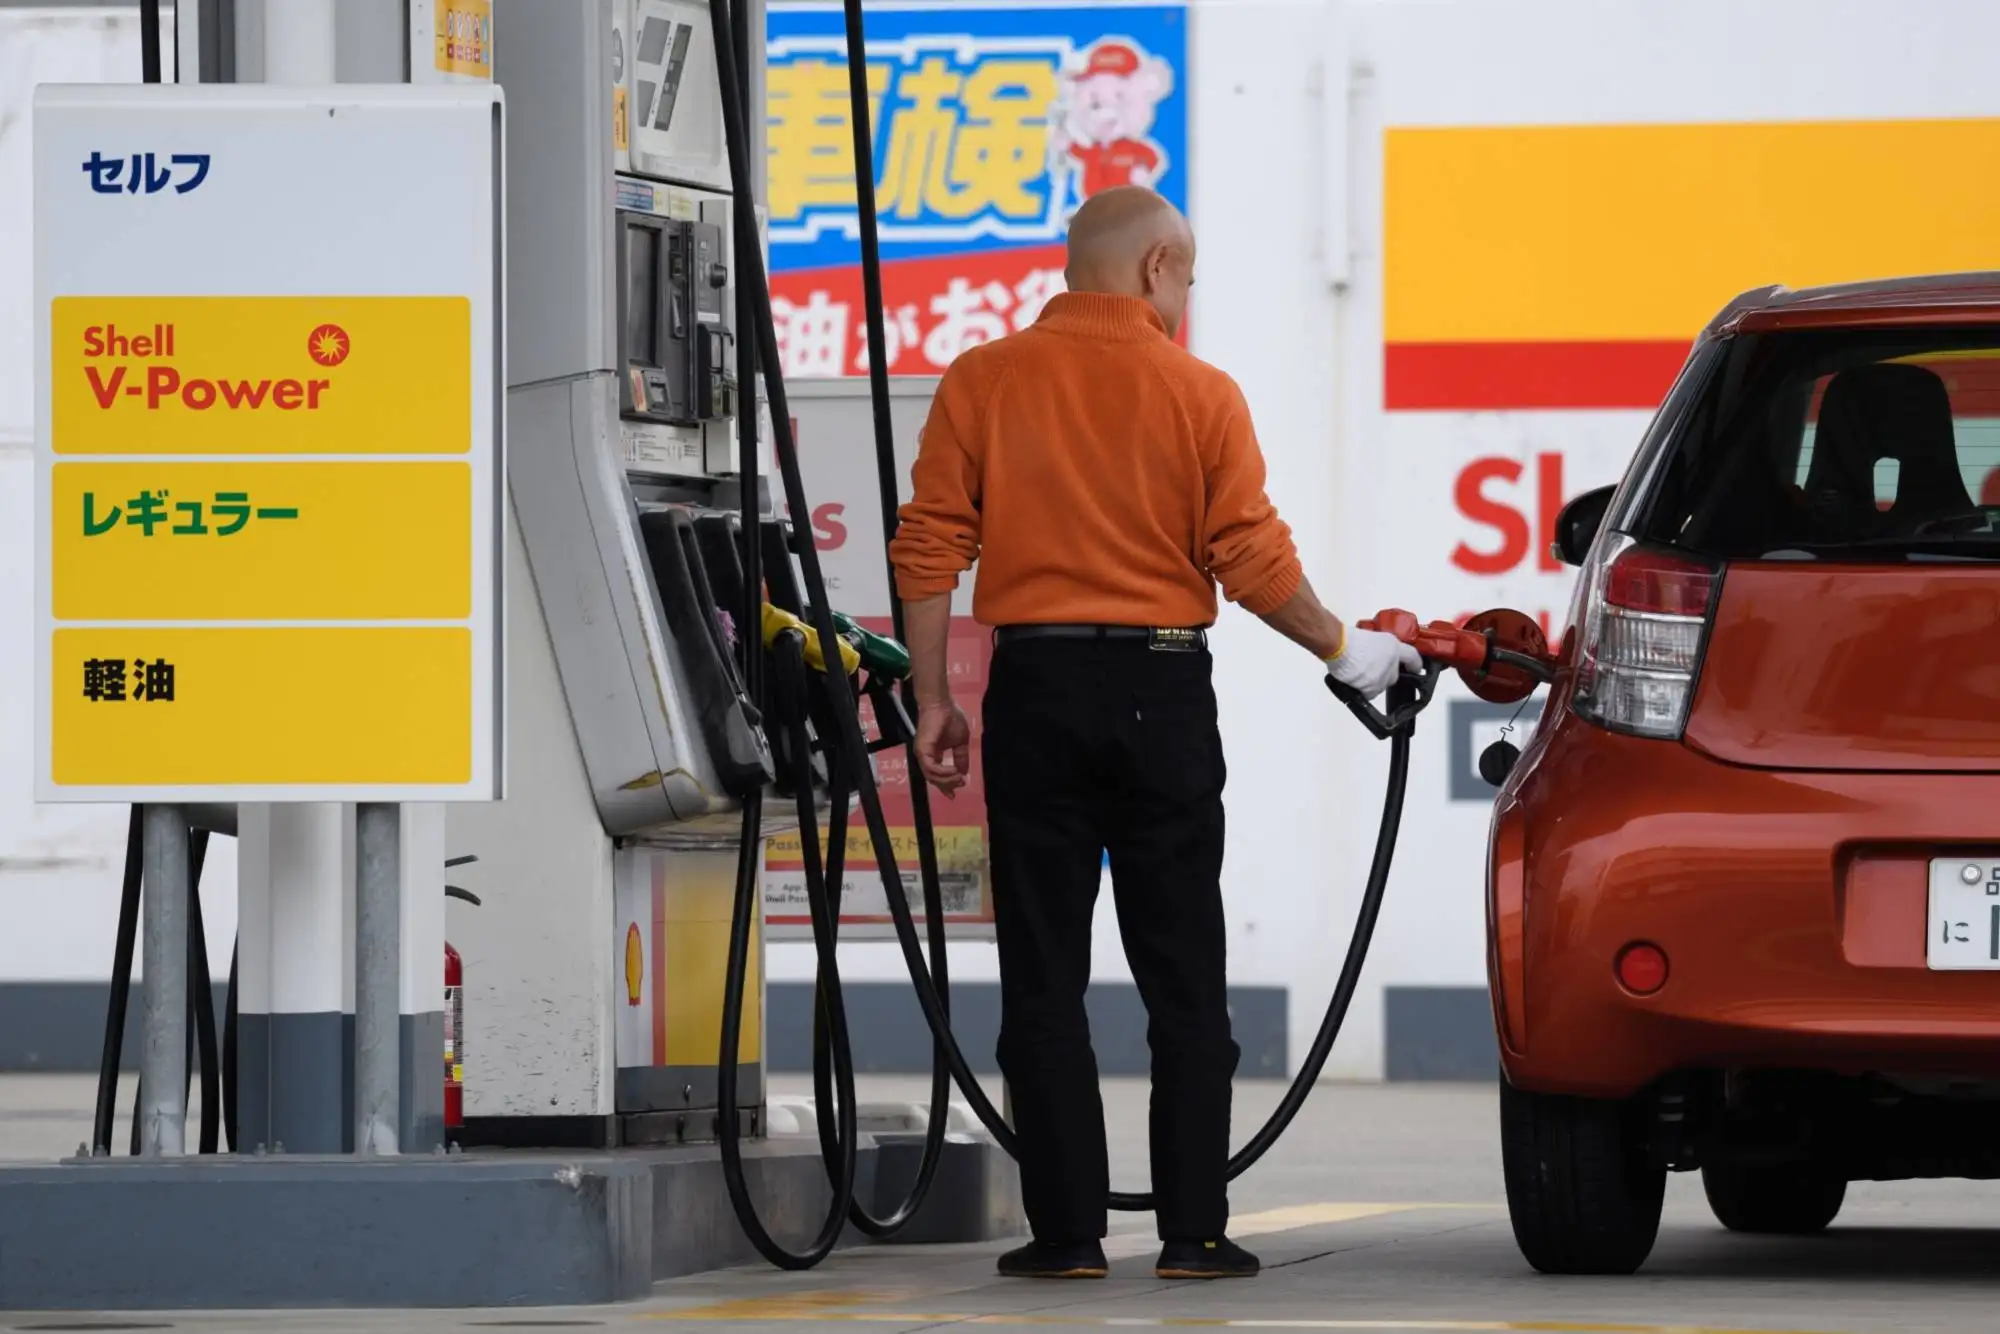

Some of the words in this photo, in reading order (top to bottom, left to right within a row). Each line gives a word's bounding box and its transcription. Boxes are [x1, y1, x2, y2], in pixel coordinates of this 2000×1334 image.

[82, 151, 211, 195] セルフ
[84, 324, 174, 357] Shell
[84, 367, 330, 410] V-Power
[83, 489, 299, 537] レギュラー
[83, 658, 176, 703] 軽油
[1942, 919, 1970, 945] に
